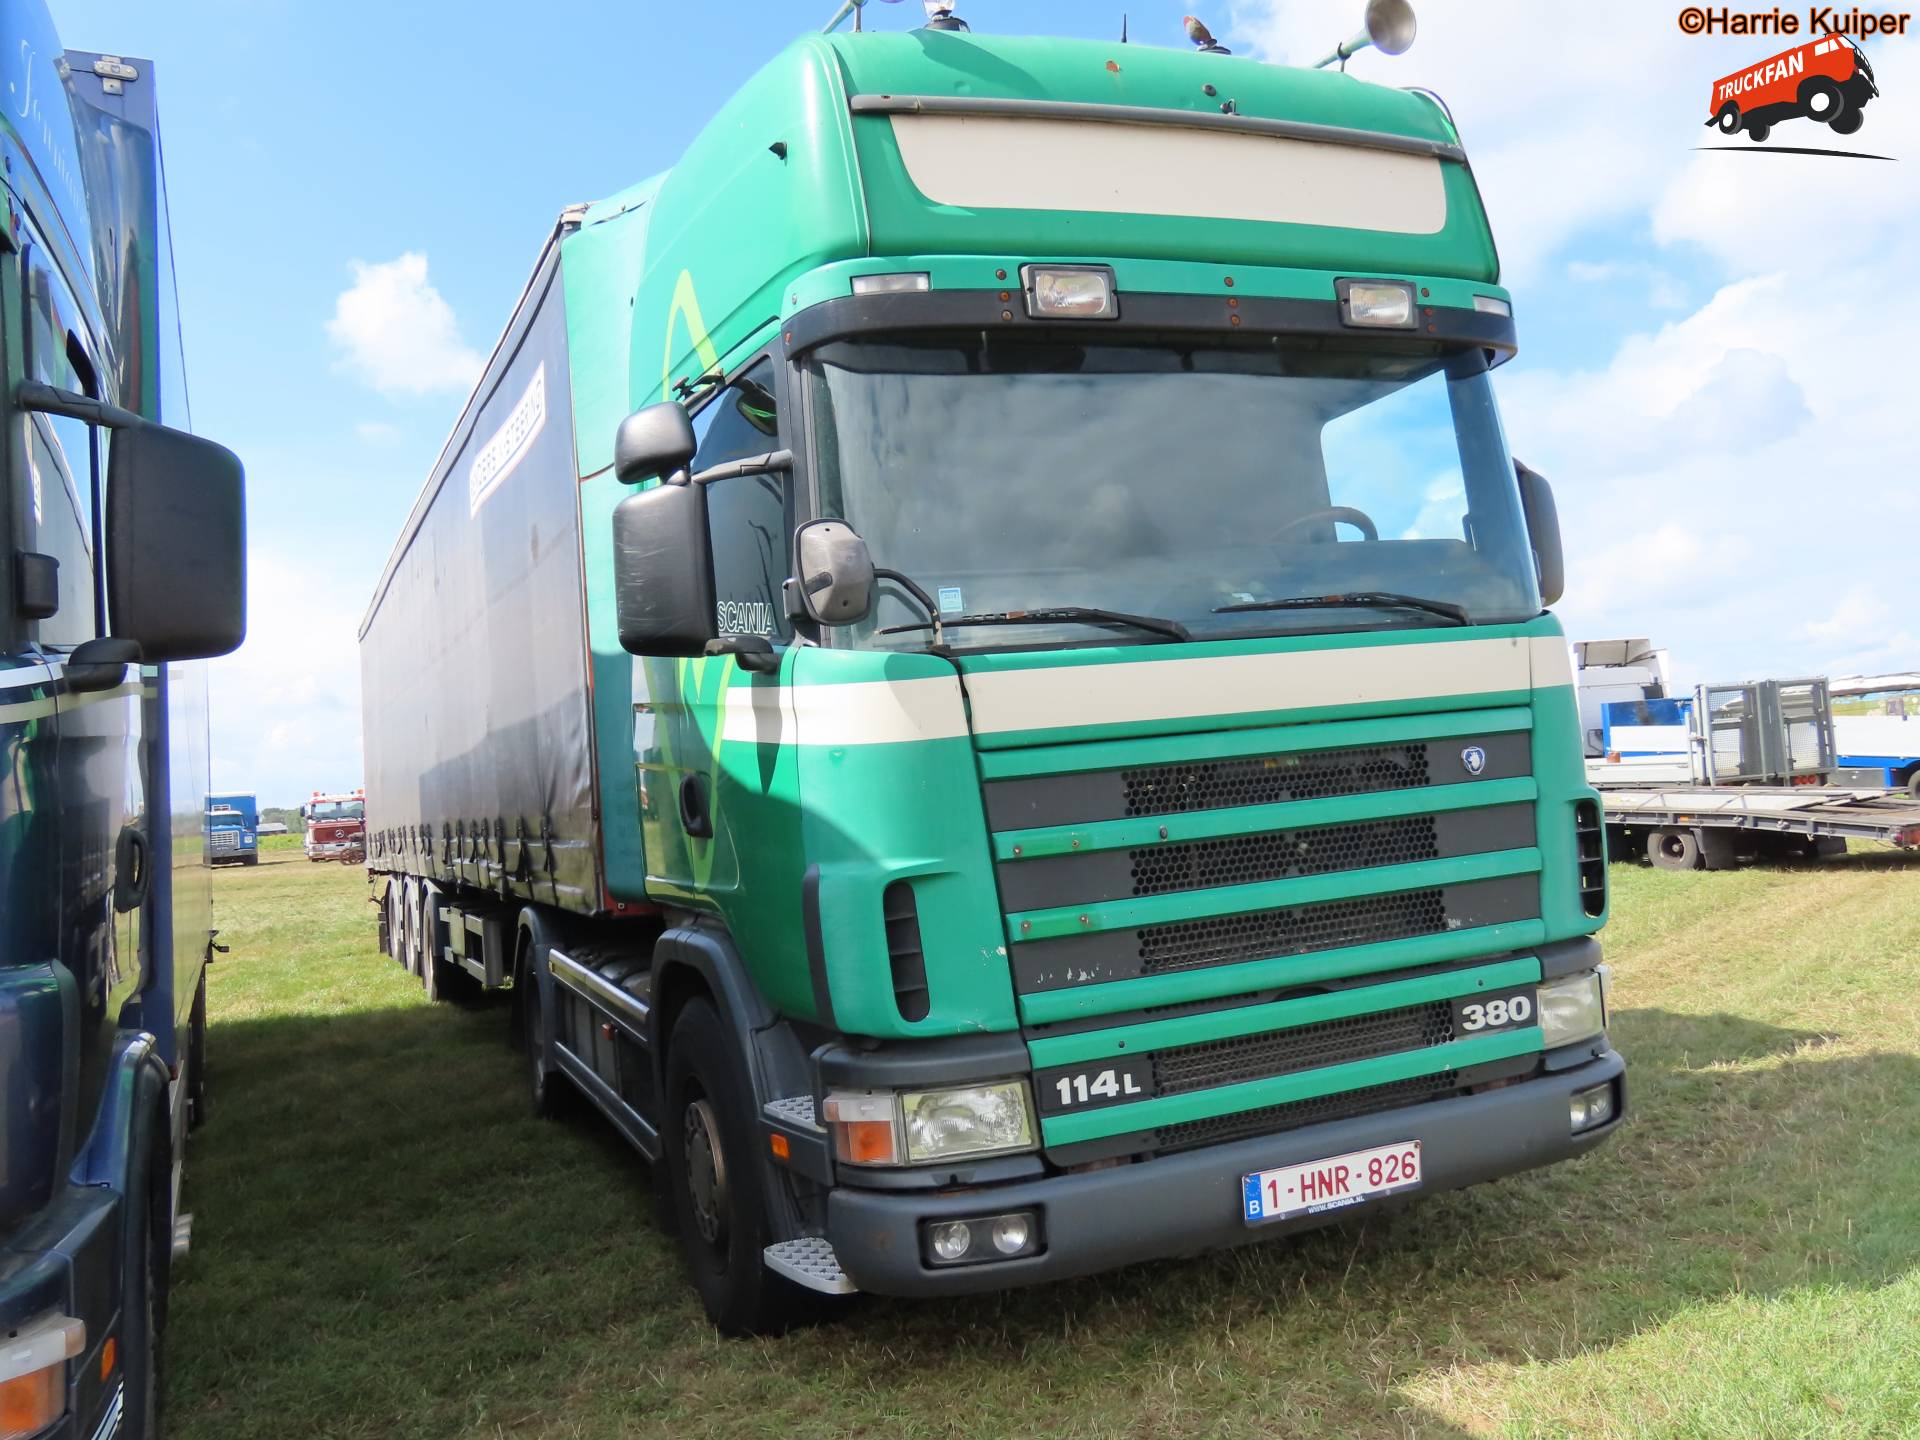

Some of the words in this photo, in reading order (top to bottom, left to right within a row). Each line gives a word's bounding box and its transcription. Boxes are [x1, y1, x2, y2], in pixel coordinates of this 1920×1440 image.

[717, 601, 776, 634] SCANIA
[1461, 995, 1532, 1031] 380
[1249, 1200, 1260, 1214] B
